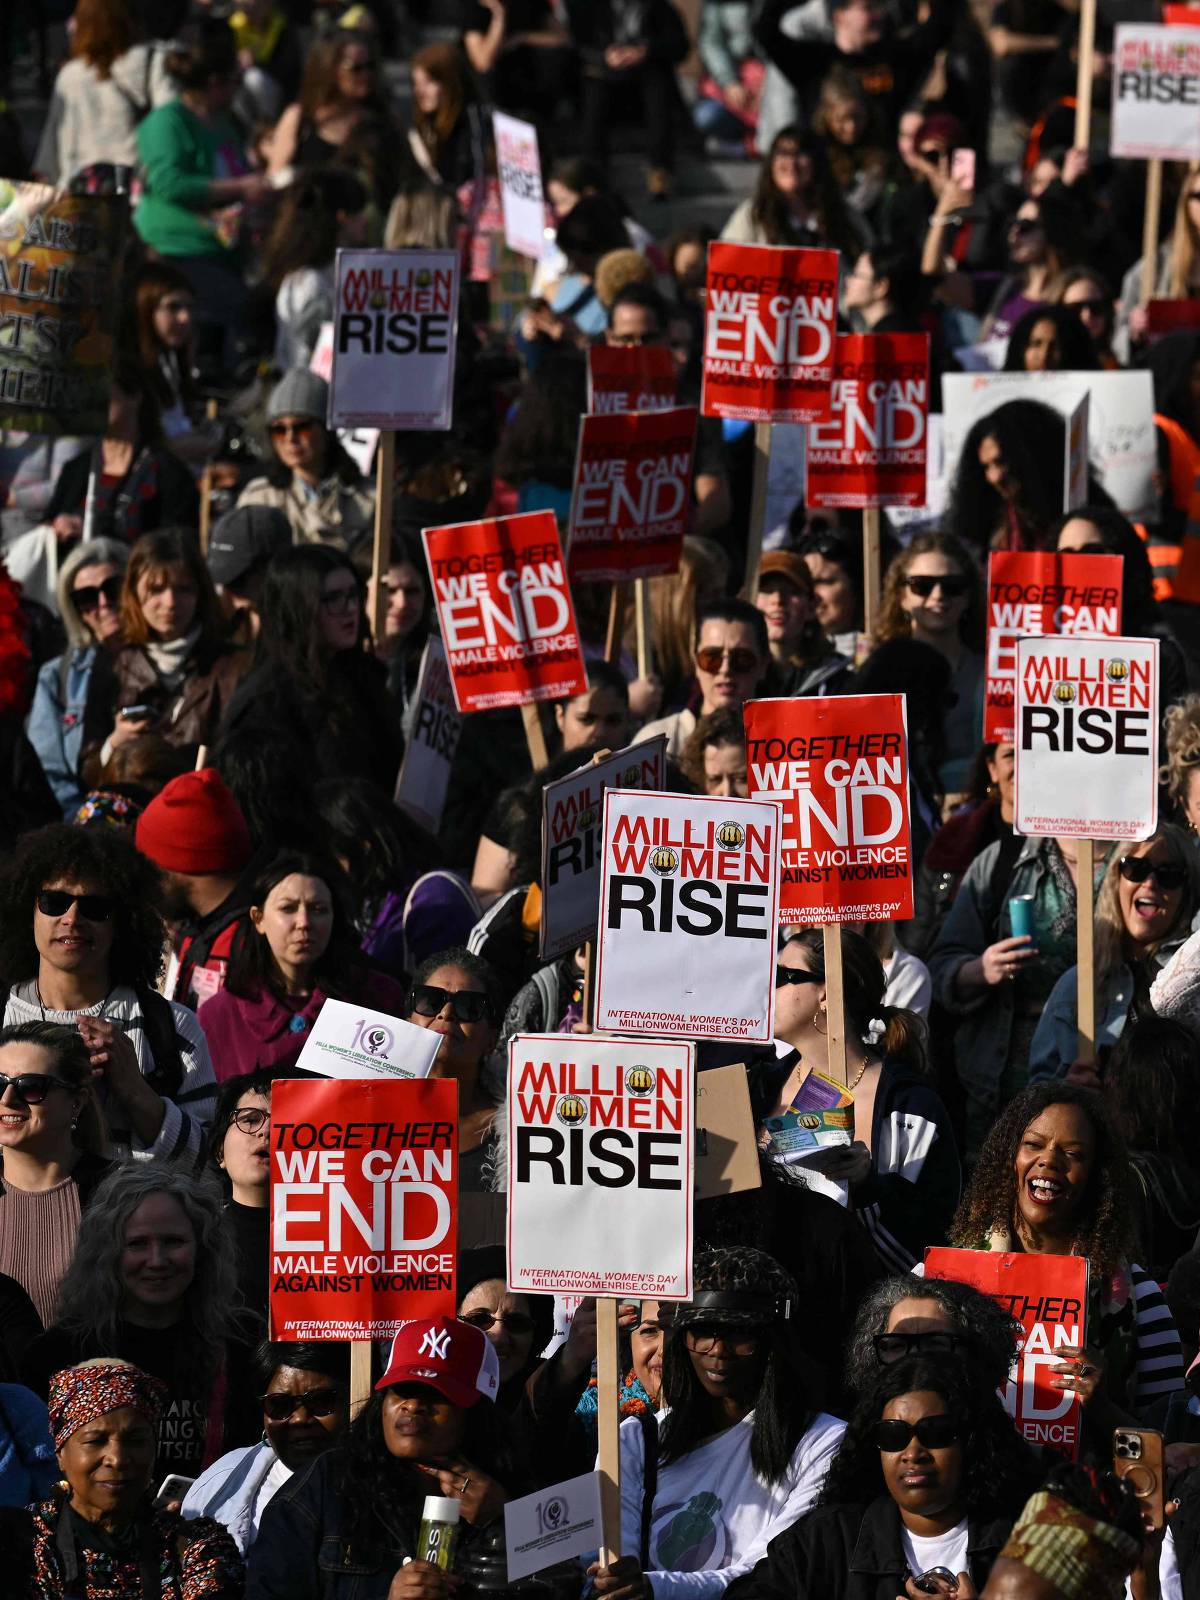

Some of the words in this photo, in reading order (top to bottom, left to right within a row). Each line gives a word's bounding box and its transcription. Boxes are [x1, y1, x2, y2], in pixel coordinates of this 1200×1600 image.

[1120, 72, 1199, 105] RISE
[710, 272, 835, 296] TOGETHER
[710, 289, 759, 317] WE
[769, 295, 833, 321] CAN
[338, 314, 449, 355] RISE
[706, 312, 831, 366] END
[705, 359, 752, 378] MALE
[755, 364, 830, 381] VIOLENCE
[867, 380, 926, 404] CAN
[583, 459, 627, 483] WE
[636, 453, 689, 481] CAN
[808, 450, 850, 465] MALE
[575, 475, 685, 527] END
[434, 543, 559, 577] TOGETHER
[438, 573, 487, 601] WE
[497, 561, 564, 595] CAN
[992, 584, 1118, 607] TOGETHER
[440, 586, 569, 650] END
[992, 603, 1042, 629] WE
[1054, 605, 1117, 633] CAN
[450, 647, 497, 666] MALE
[499, 634, 577, 660] VIOLENCE
[1022, 706, 1149, 756] RISE
[750, 733, 900, 762] TOGETHER
[751, 761, 811, 791] WE
[824, 757, 902, 788] CAN
[1024, 817, 1087, 826] INTERNATIONAL
[1130, 821, 1146, 829] DAY
[814, 847, 907, 866] VIOLENCE
[838, 864, 907, 881] WOMEN
[608, 875, 768, 939] RISE
[838, 904, 881, 913] WOMEN'S
[883, 903, 900, 911] DAY
[608, 1010, 686, 1022] INTERNATIONAL
[690, 1015, 737, 1025] WOMEN'S
[739, 1019, 760, 1027] DAY
[619, 1019, 748, 1035] MILLIONWOMENRISE.COM
[273, 1123, 453, 1149] TOGETHER
[275, 1151, 345, 1183] WE
[362, 1149, 452, 1182] CAN
[517, 1126, 682, 1190] RISE
[273, 1182, 451, 1252] END
[274, 1256, 336, 1274] MALE
[344, 1254, 453, 1273] VIOLENCE
[520, 1269, 601, 1280] INTERNATIONAL
[605, 1272, 654, 1282] WOMEN'S
[657, 1275, 678, 1283] DAY
[273, 1276, 364, 1293] AGAINST
[371, 1274, 452, 1291] WOMEN
[532, 1279, 665, 1292] MILLIONWOMENRISE.COM
[284, 1320, 365, 1330] INTERNATIONAL
[418, 1326, 451, 1360] NY
